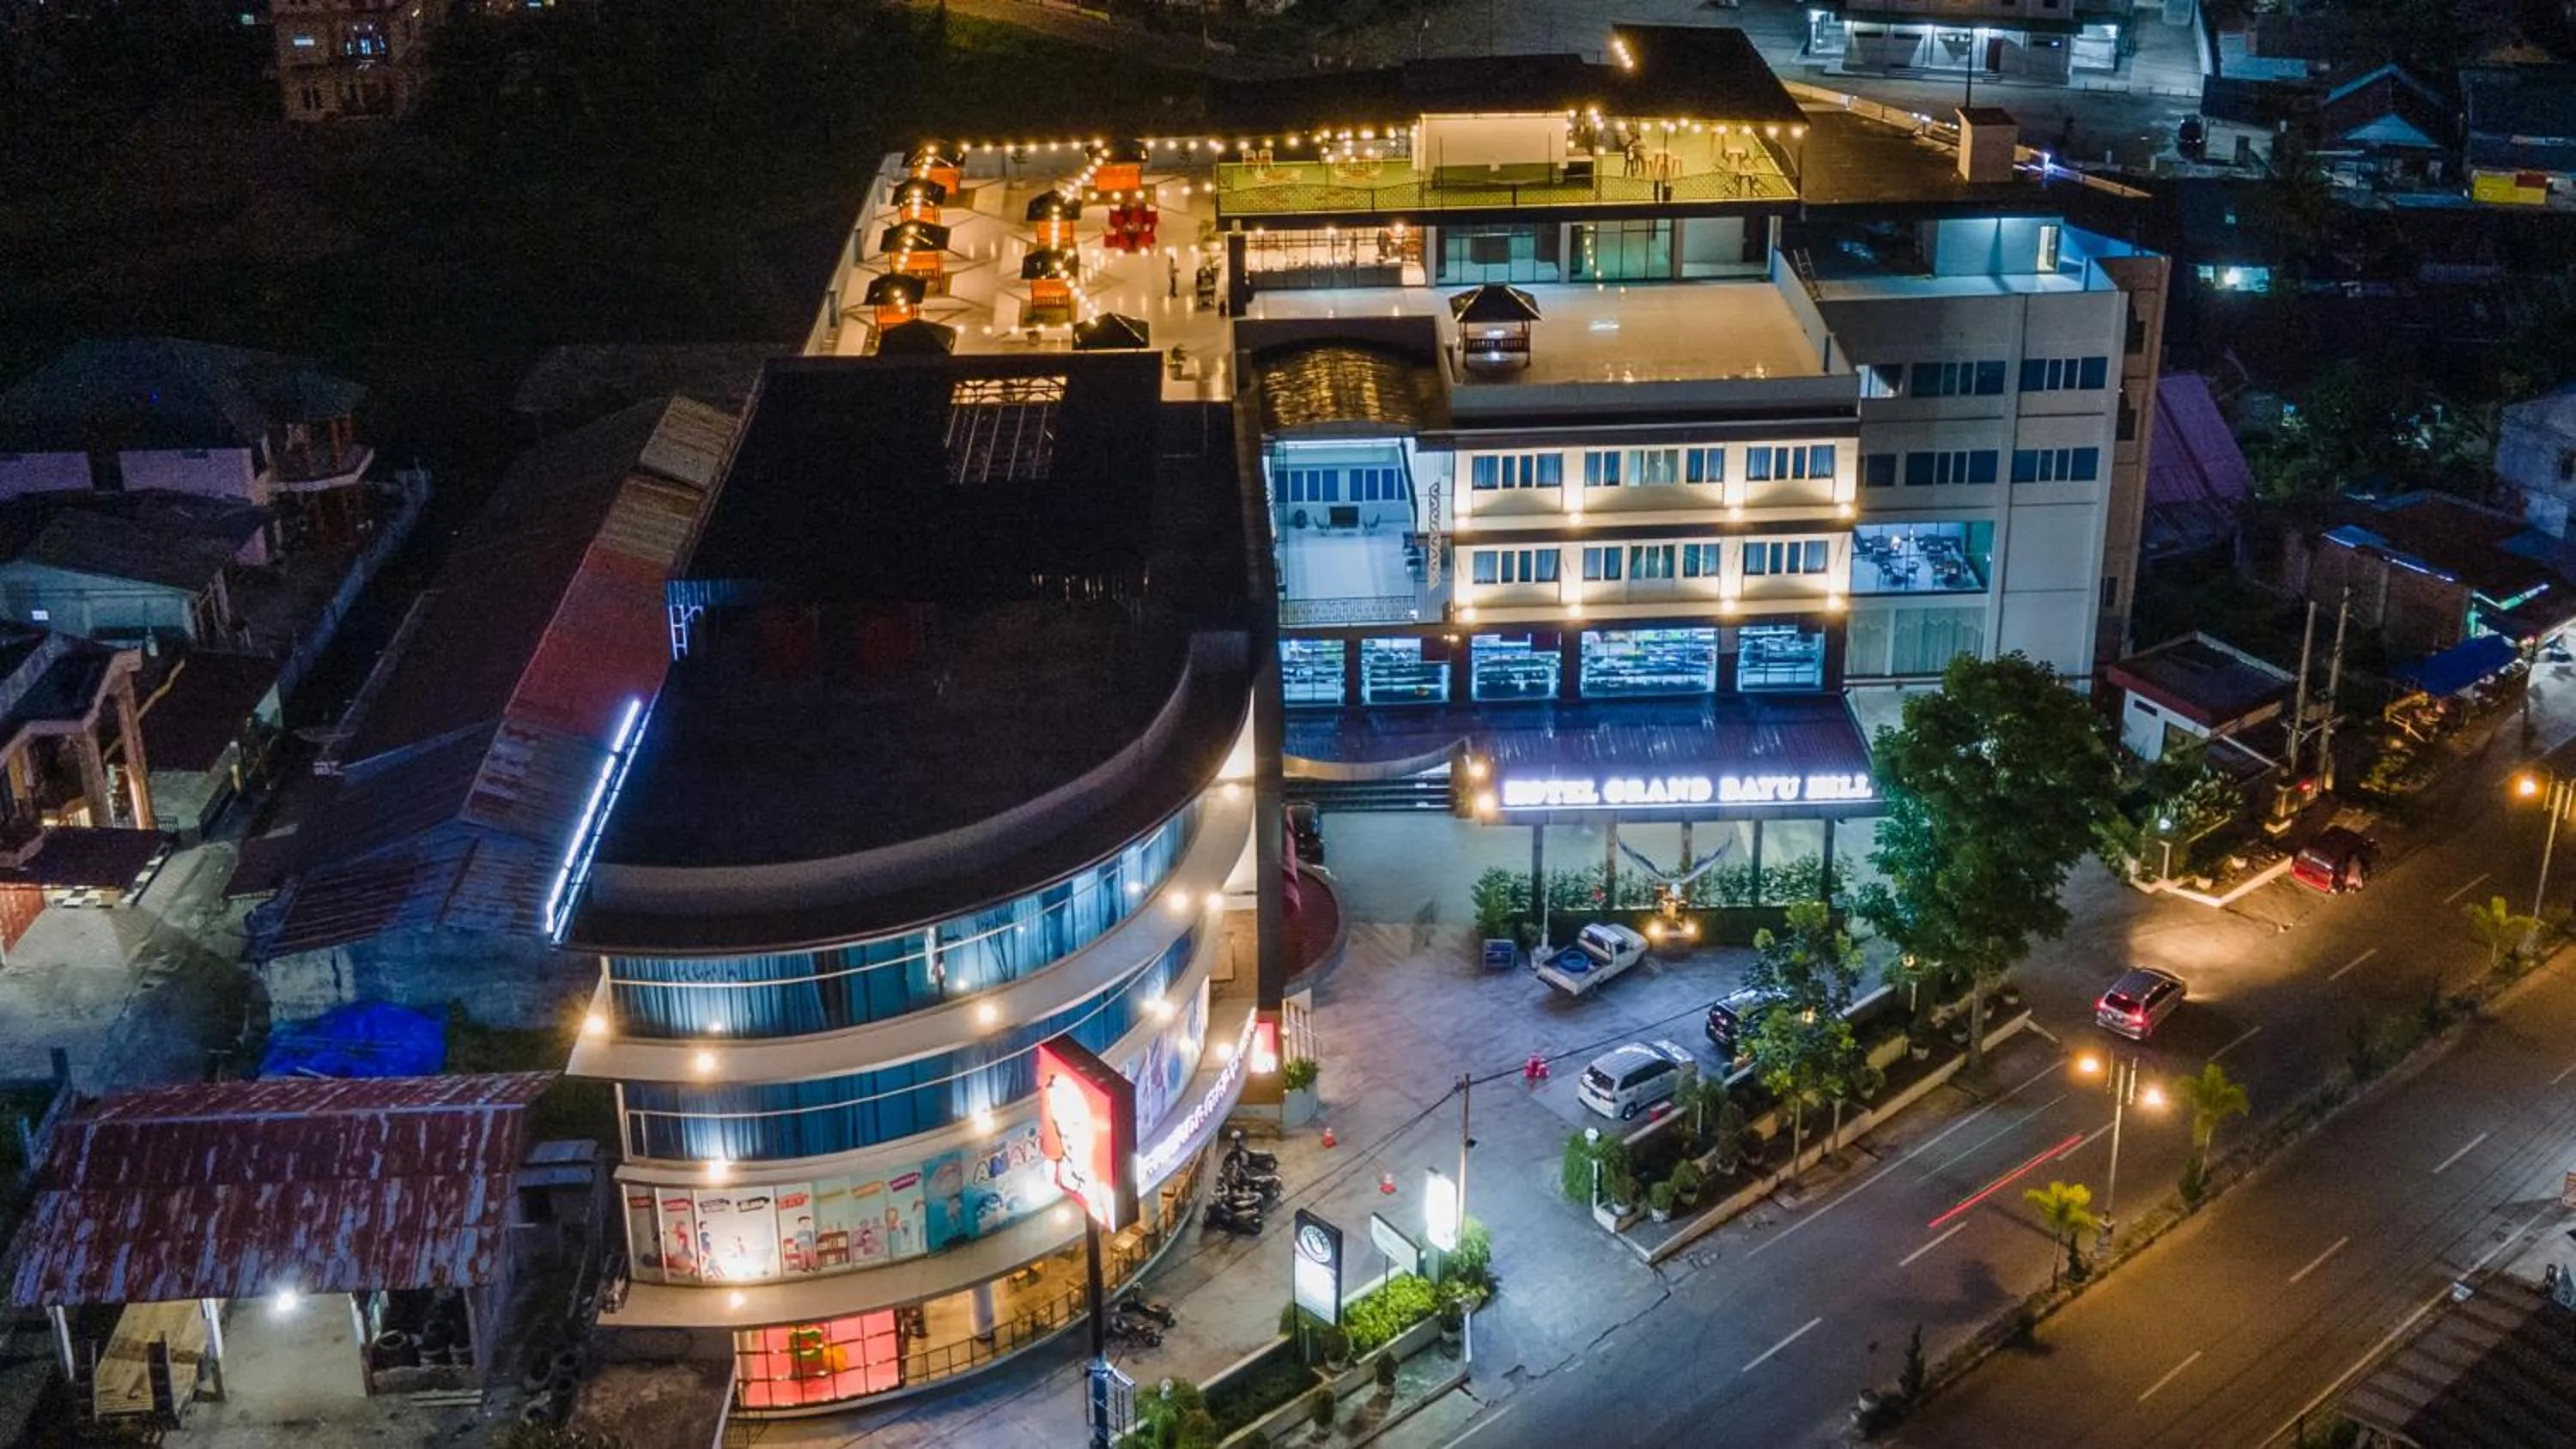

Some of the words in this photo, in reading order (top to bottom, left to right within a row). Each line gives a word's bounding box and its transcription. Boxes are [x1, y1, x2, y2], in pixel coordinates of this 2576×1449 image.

[1504, 780, 1598, 804] HOTEL
[1603, 778, 1712, 803] GRAND
[1806, 773, 1872, 798] HILL
